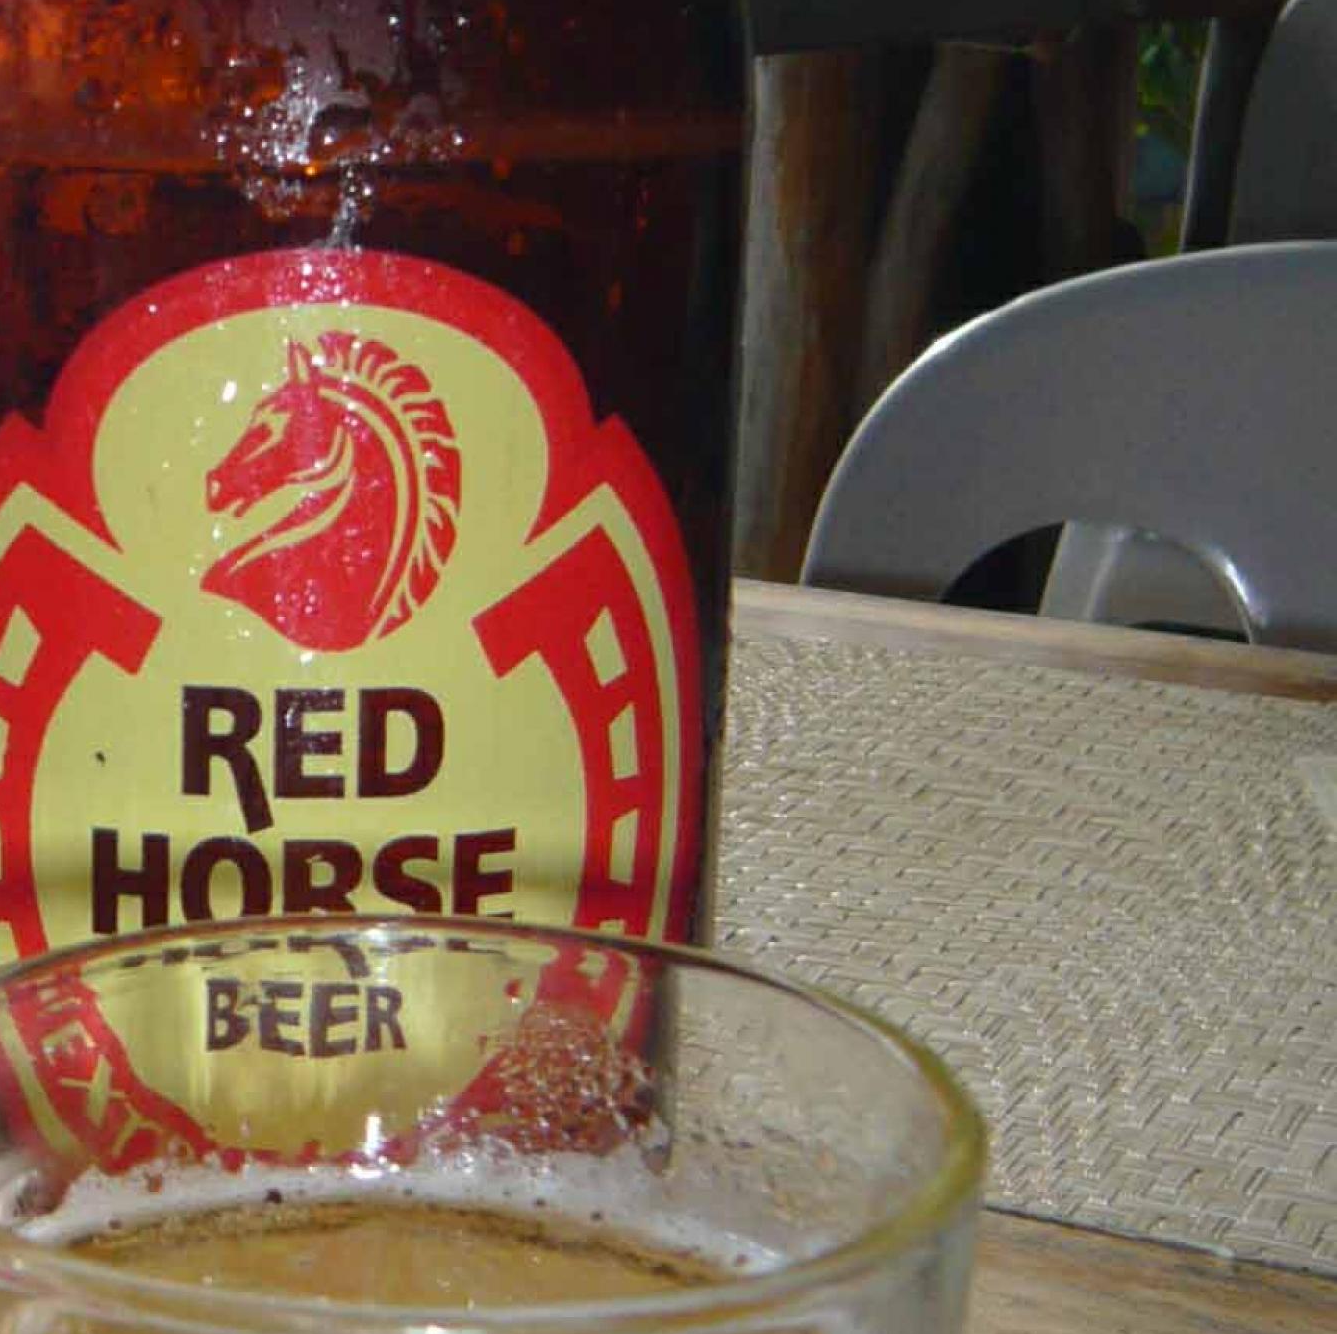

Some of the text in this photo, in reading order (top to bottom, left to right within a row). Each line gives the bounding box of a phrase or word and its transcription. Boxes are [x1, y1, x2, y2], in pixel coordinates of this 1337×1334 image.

[182, 685, 445, 834] RED
[91, 827, 516, 957] HORSE
[206, 979, 407, 1058] BEER
